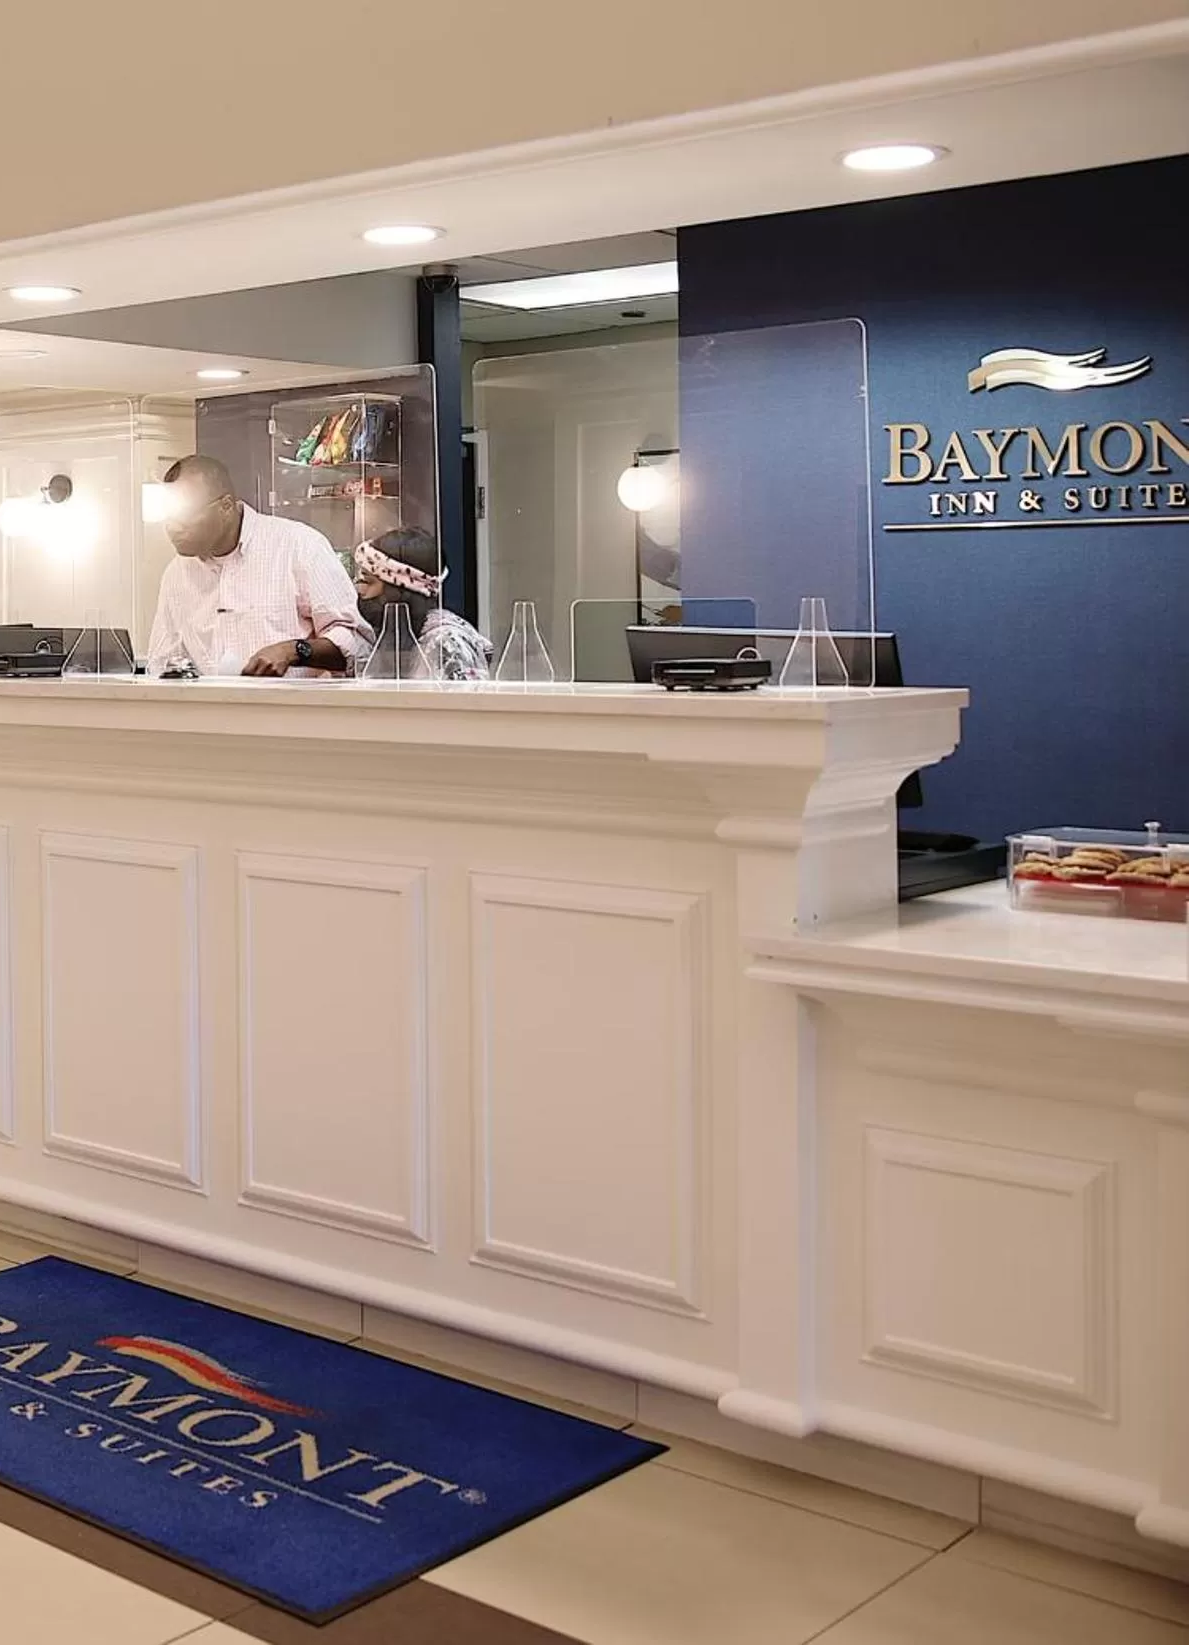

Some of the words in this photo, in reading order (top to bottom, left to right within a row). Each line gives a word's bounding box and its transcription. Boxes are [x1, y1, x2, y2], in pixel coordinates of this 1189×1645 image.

[929, 491, 997, 516] INN
[1018, 488, 1042, 511] &
[1063, 484, 1189, 511] SUITE
[9, 1401, 49, 1421] &
[64, 1422, 279, 1508] SUITES
